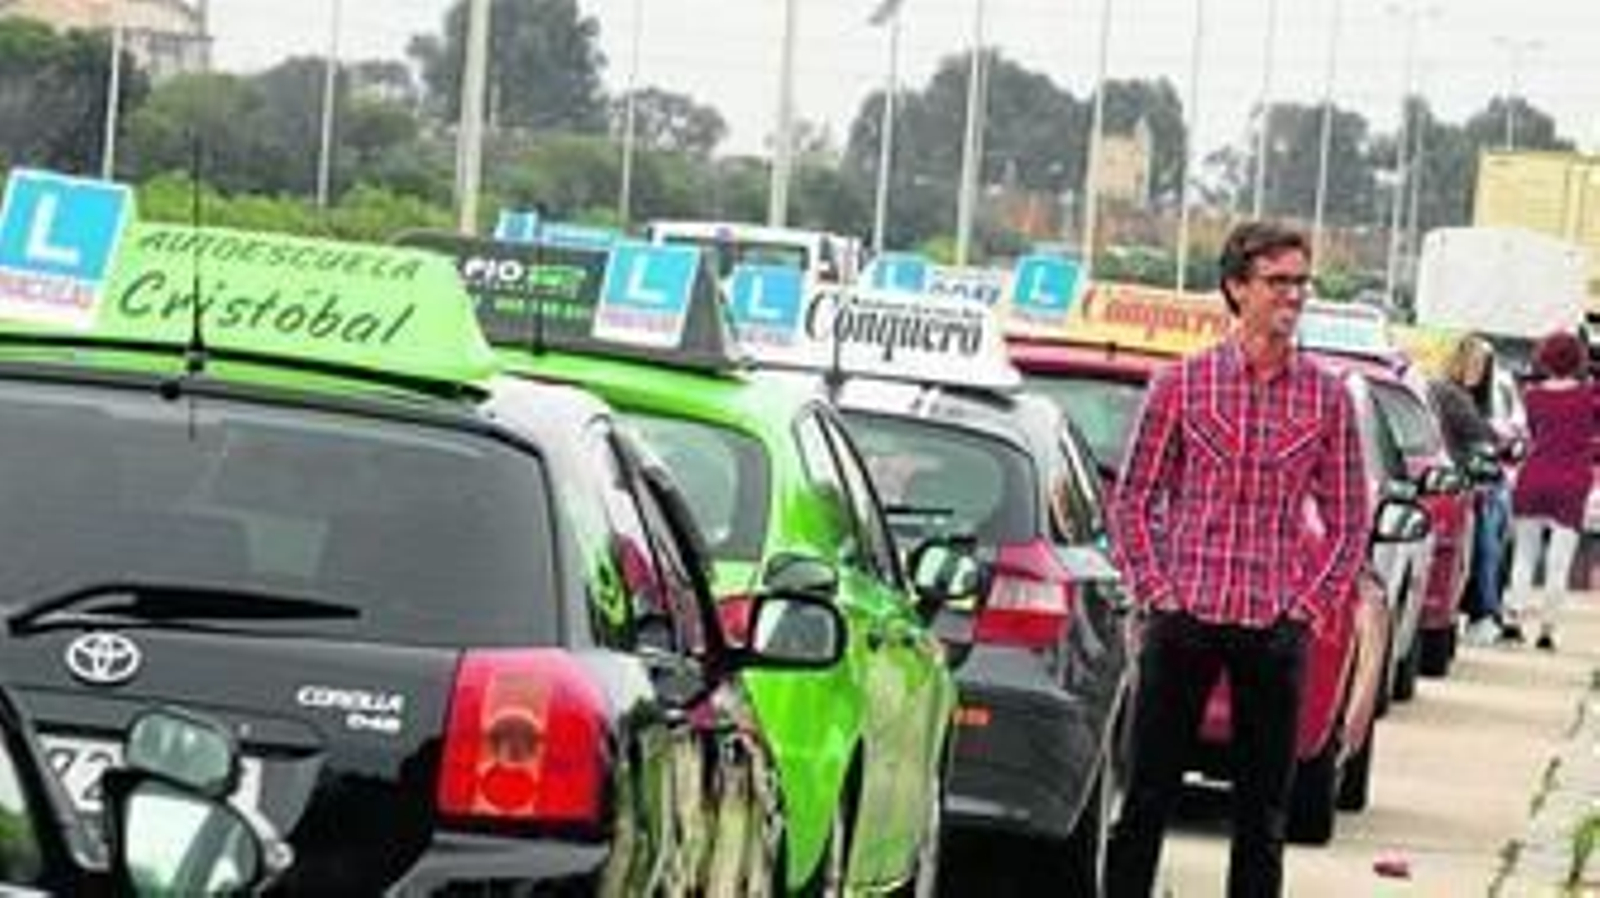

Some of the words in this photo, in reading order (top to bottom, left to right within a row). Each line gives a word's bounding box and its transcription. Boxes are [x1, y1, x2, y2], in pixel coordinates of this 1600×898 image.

[26, 193, 81, 264] L
[138, 231, 424, 281] AUTOESCUELA
[625, 253, 667, 302] L
[749, 274, 781, 319] L
[1029, 263, 1058, 304] L
[804, 291, 983, 361] Conquero
[298, 685, 405, 712] COROLLA
